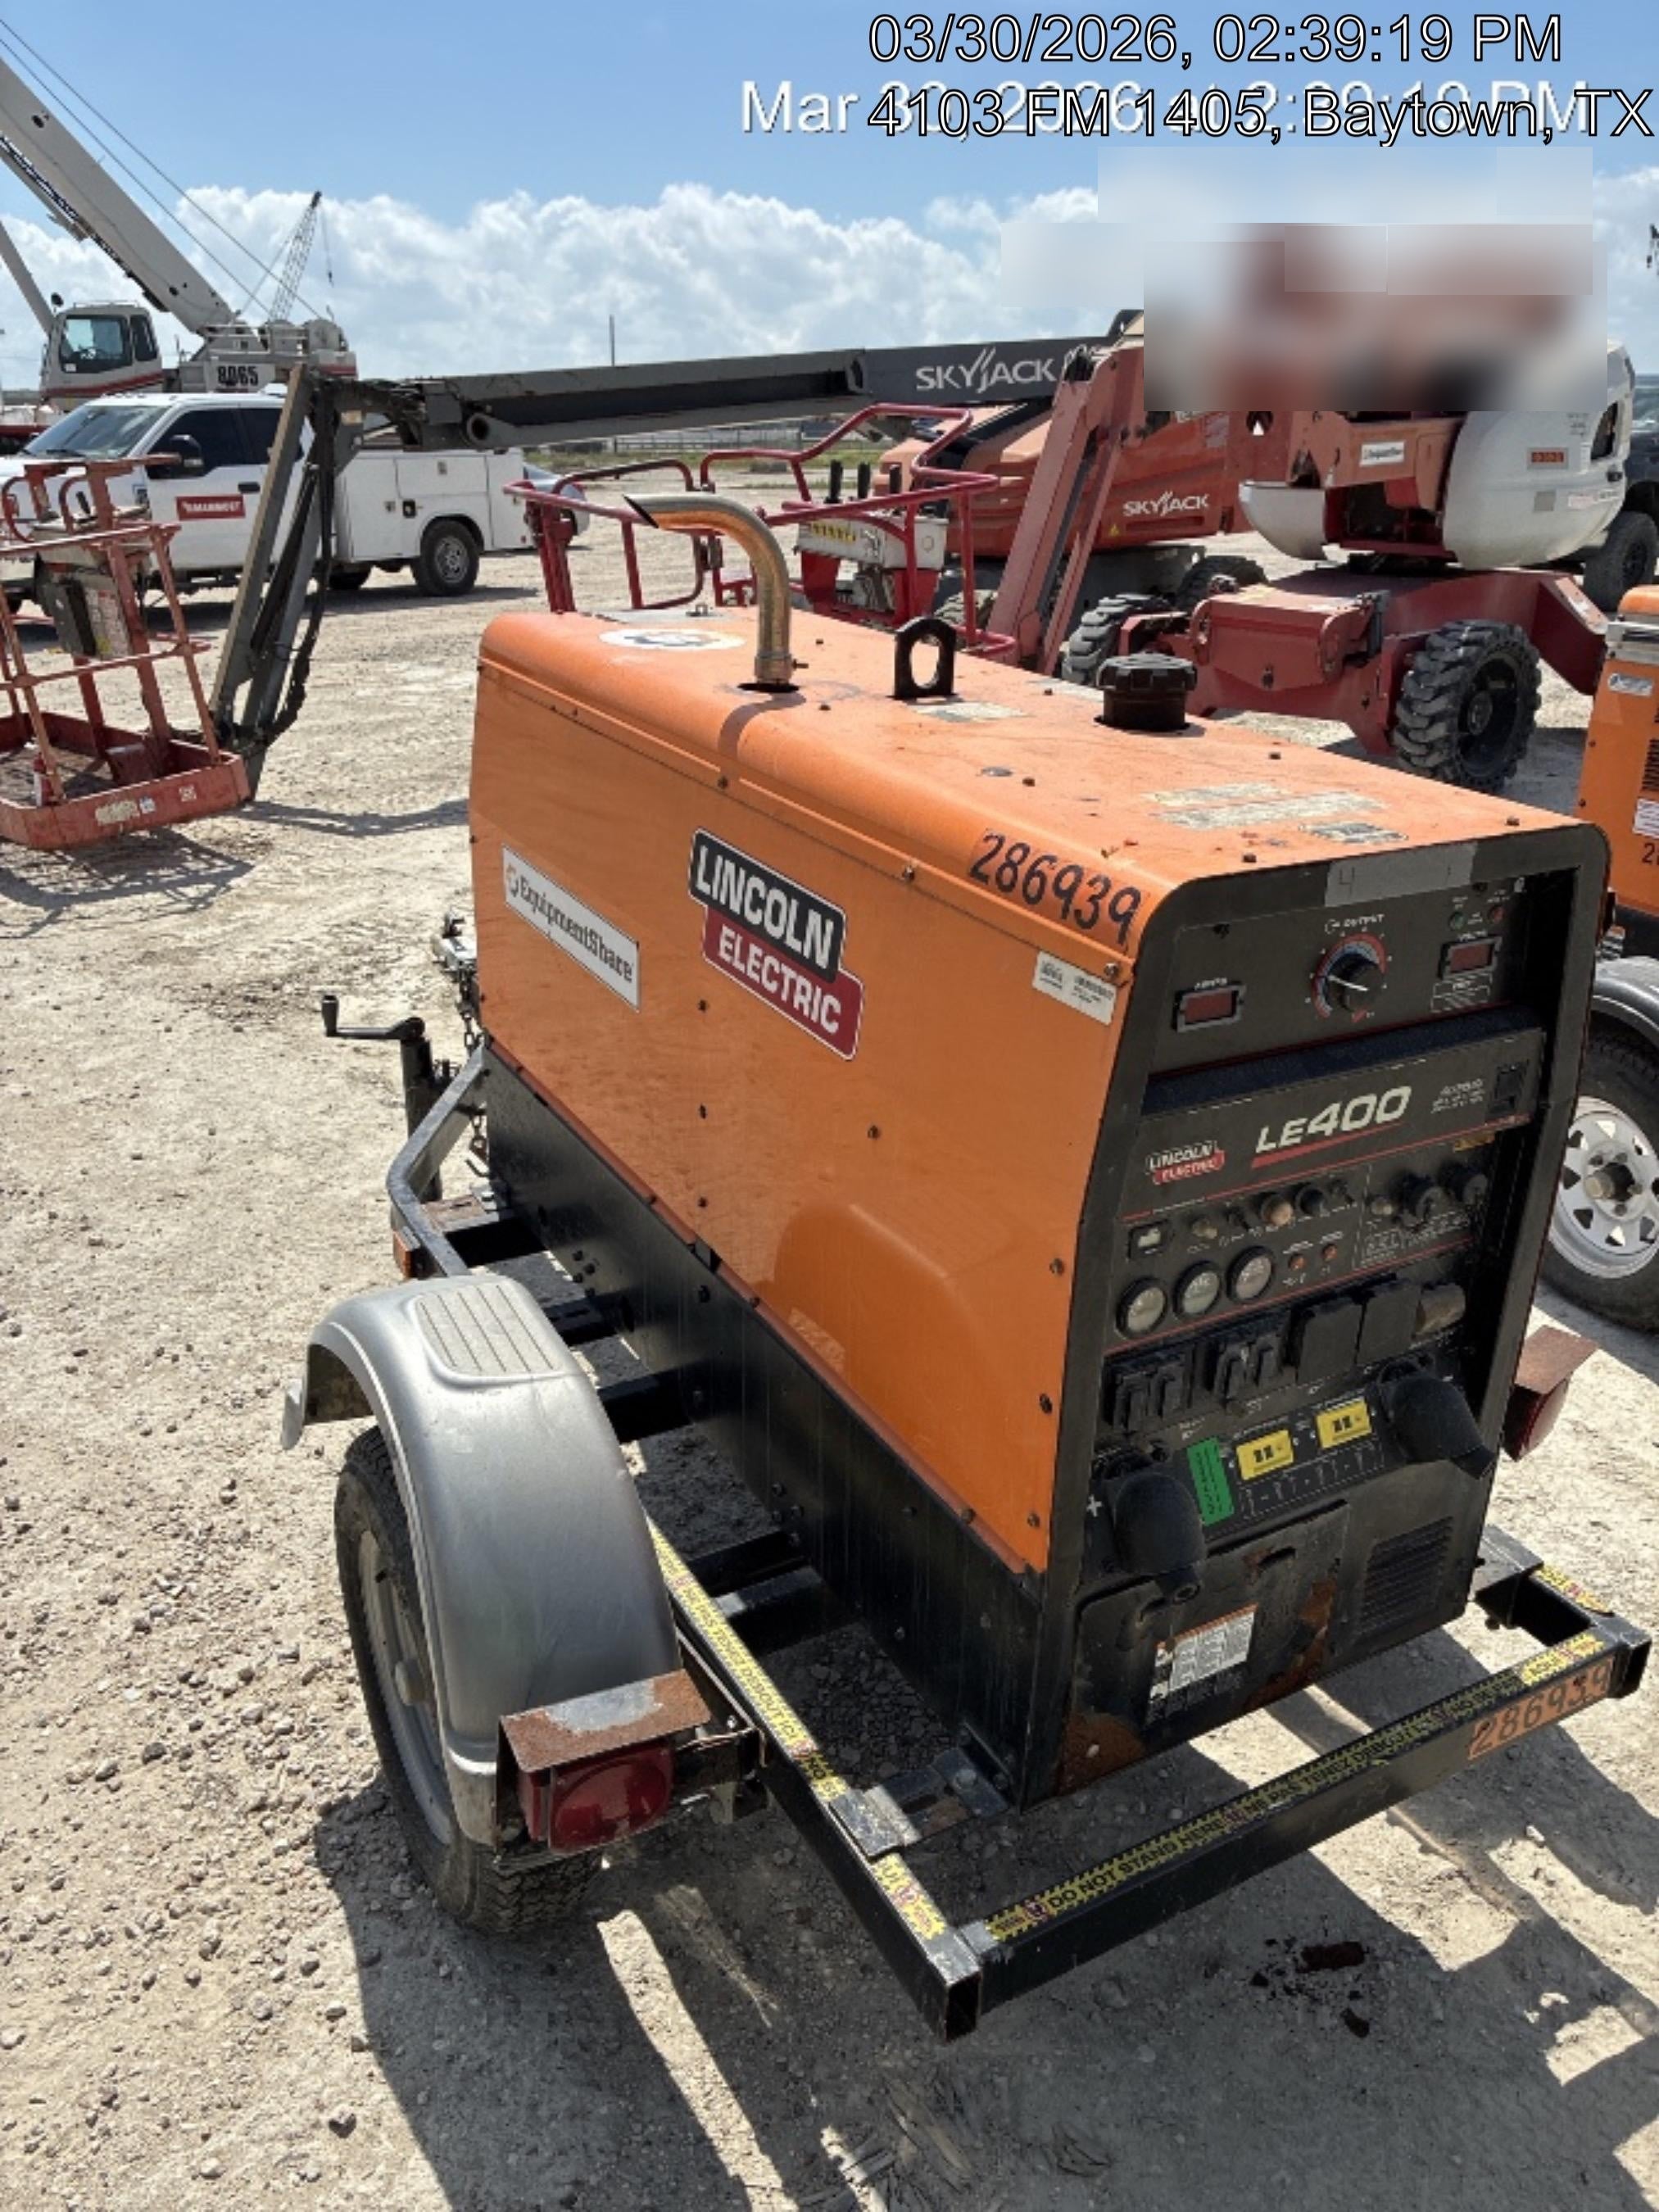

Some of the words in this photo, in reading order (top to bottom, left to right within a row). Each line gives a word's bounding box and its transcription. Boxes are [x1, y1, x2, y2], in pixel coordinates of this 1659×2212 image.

[217, 365, 259, 387] 8065
[915, 347, 1058, 394] SKYJACK
[1122, 491, 1210, 517] SKYJACK
[520, 875, 634, 982] EquipmentShare
[696, 845, 834, 970] LINCOLN
[969, 832, 1141, 945] 286939
[718, 925, 841, 1035] ELECTRIC
[1255, 1086, 1412, 1154] LE400
